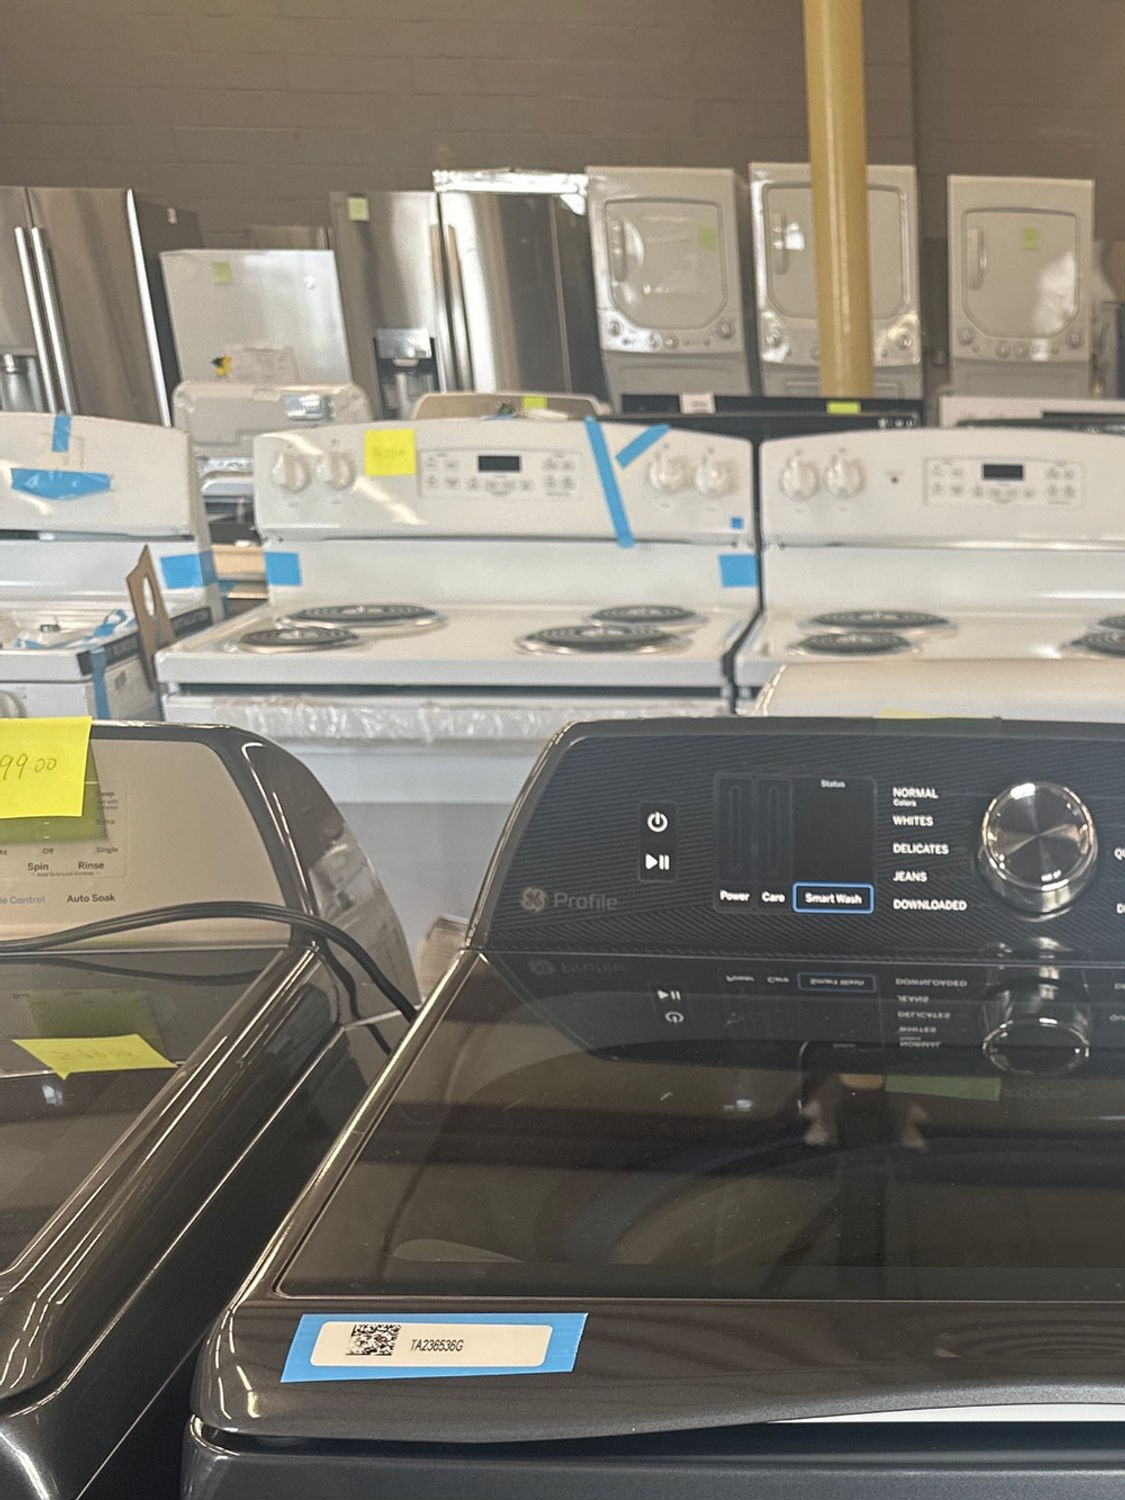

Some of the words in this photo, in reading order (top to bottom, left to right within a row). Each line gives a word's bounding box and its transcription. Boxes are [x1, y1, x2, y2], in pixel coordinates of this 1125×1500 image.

[821, 780, 846, 789] Status
[892, 788, 939, 800] NORMAL
[892, 815, 934, 827] WHITES
[42, 847, 54, 855] Off
[892, 843, 949, 855] DELICATES
[27, 862, 49, 872] Spin
[78, 861, 104, 870] Rinse
[892, 871, 928, 882] JEANS
[10, 894, 45, 904] Control
[67, 894, 90, 903] Auto
[91, 893, 116, 903] Soak
[553, 890, 617, 911] Profile
[720, 889, 751, 902] Power
[761, 891, 786, 903] Care
[804, 892, 835, 904] Smart
[836, 892, 863, 905] Wash
[892, 899, 968, 912] DOWNLOADED
[410, 1339, 464, 1352] TA236536G
